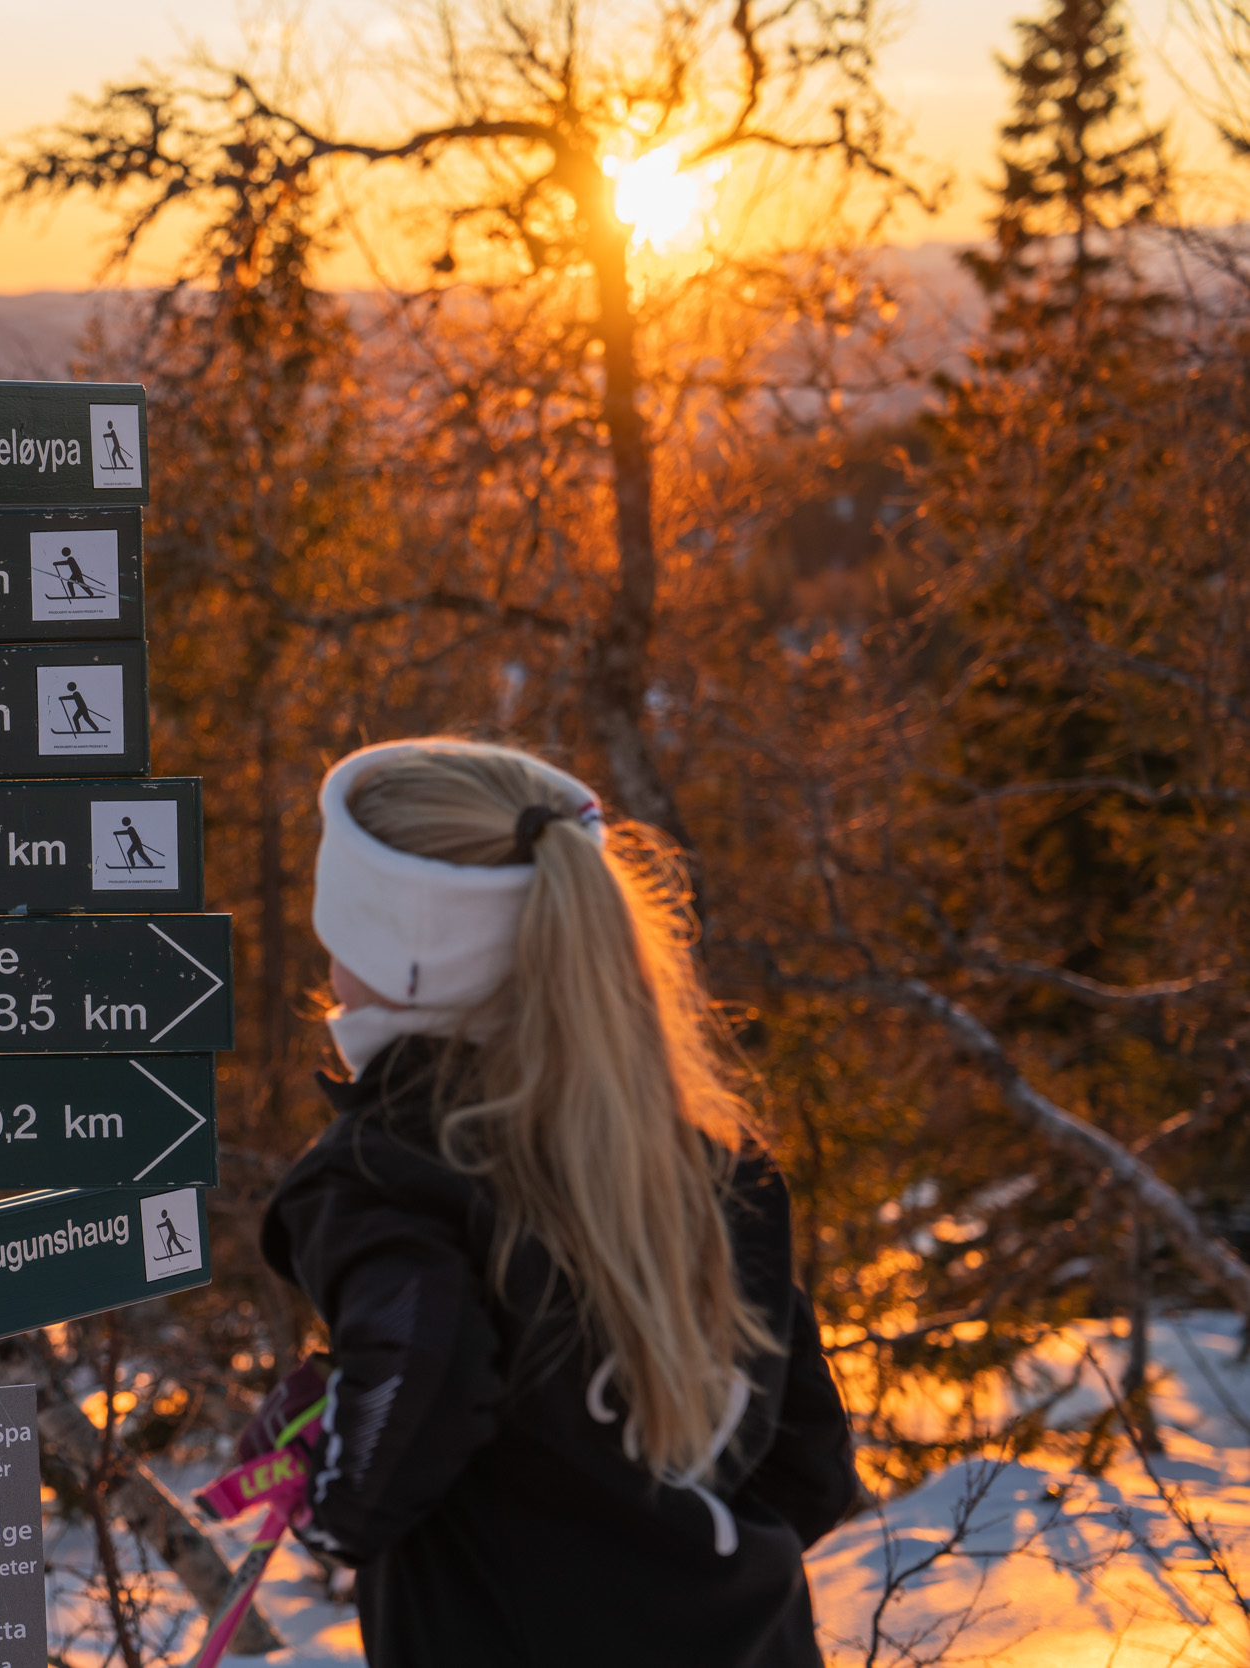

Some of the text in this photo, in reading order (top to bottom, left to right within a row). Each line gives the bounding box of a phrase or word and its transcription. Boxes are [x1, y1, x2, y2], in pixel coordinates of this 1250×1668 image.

[8, 831, 67, 866] km
[84, 993, 147, 1031] km
[64, 1104, 123, 1139] km
